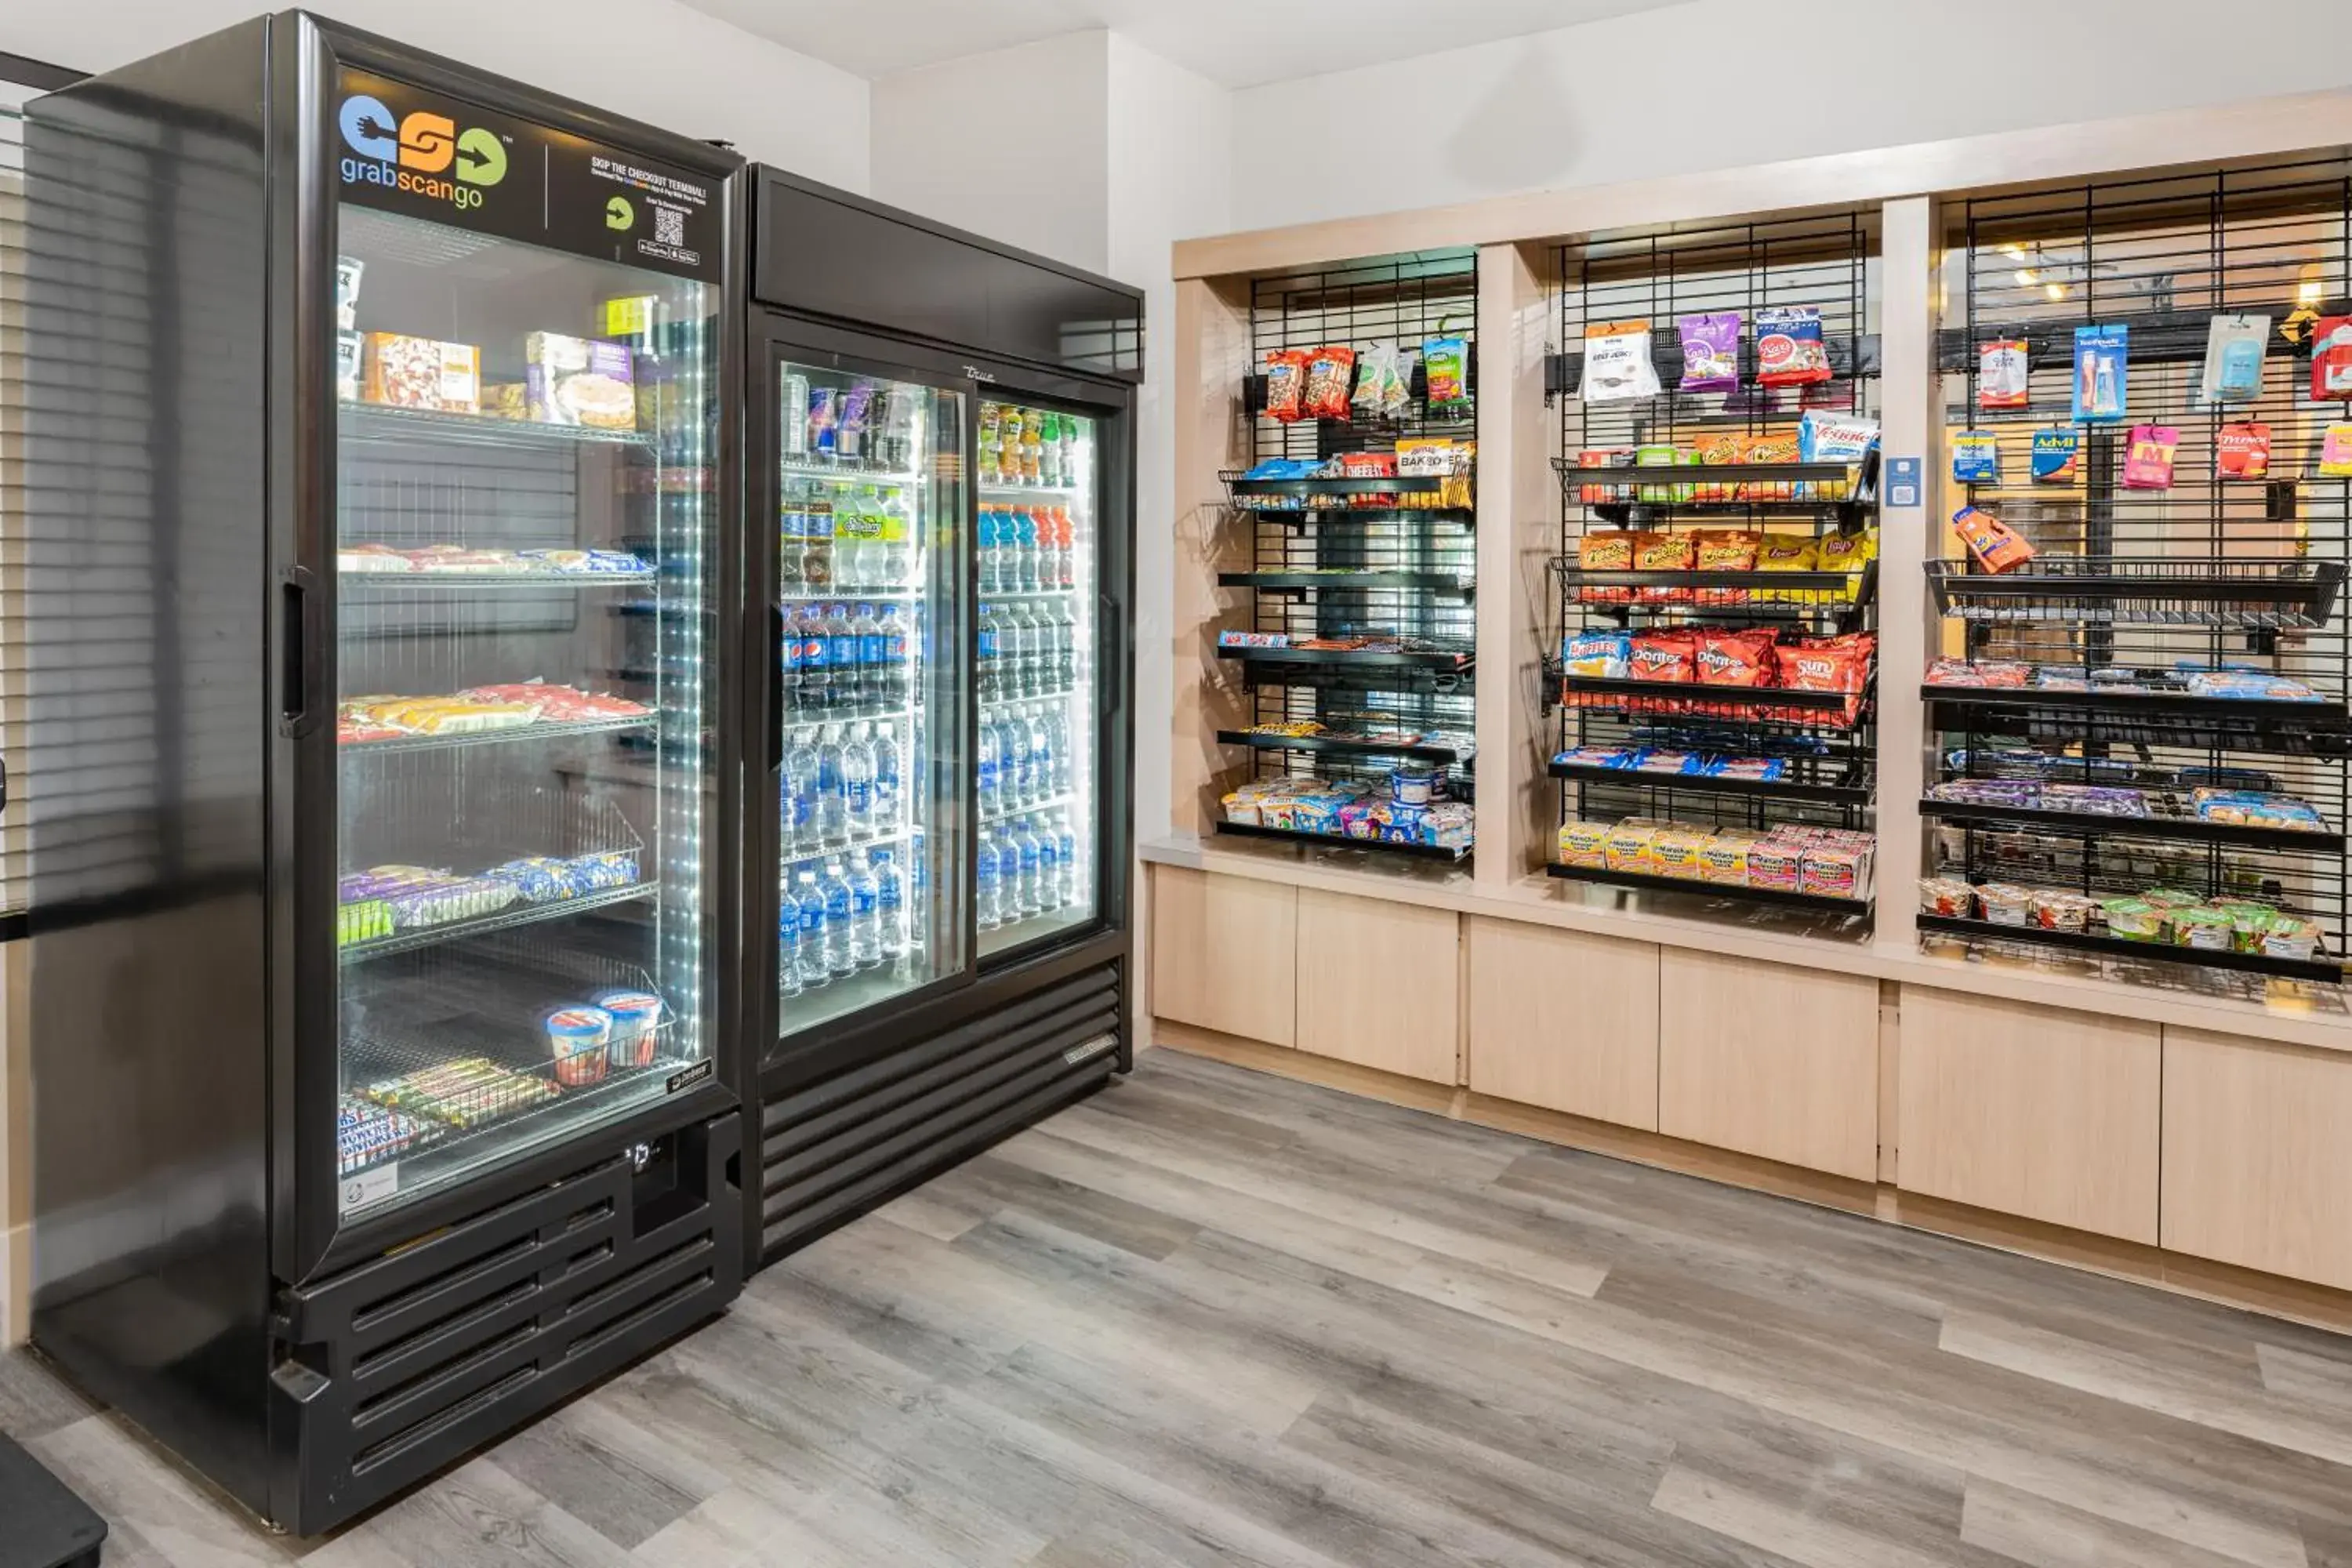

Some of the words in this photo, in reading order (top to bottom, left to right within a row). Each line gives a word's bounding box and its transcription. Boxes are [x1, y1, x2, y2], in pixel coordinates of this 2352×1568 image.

[340, 158, 483, 209] grabscango
[592, 156, 611, 170] SKIP
[612, 162, 626, 174] THE
[628, 166, 666, 187] CHECKOUT
[2035, 437, 2074, 448] Advil
